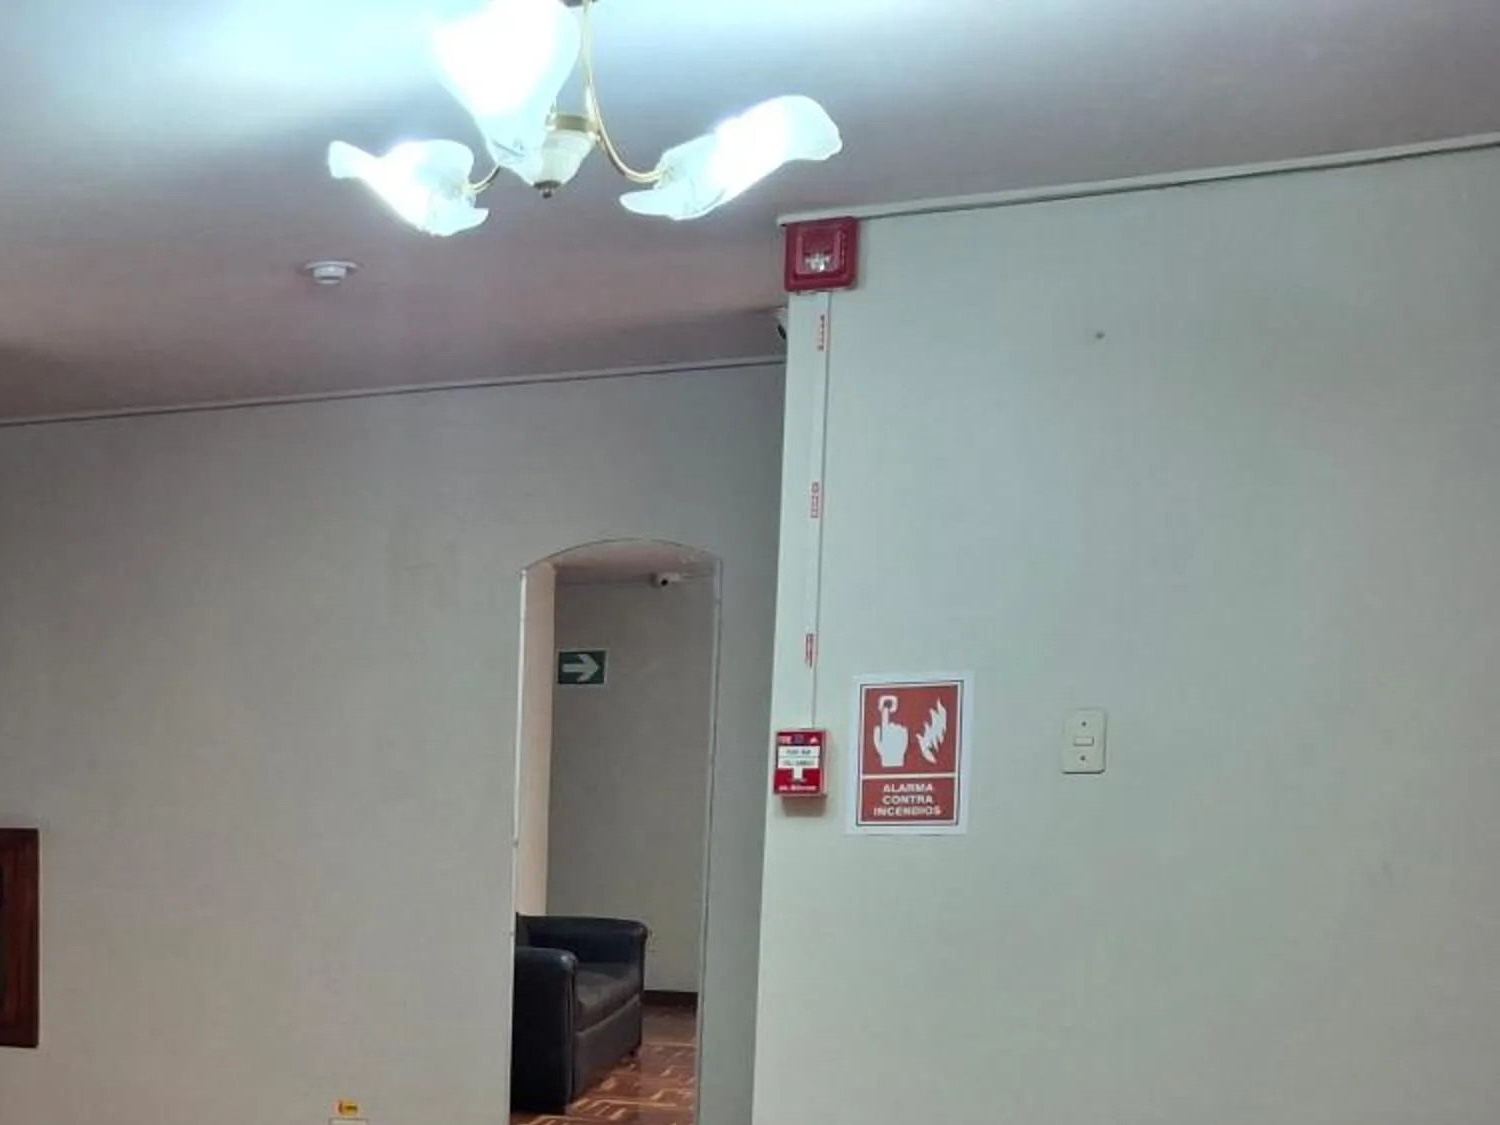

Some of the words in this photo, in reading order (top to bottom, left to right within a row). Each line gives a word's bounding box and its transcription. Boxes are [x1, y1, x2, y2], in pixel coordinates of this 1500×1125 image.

[883, 783, 934, 793] ALARMA
[882, 795, 933, 805] CONTRA
[873, 804, 942, 817] INCENDIOS
